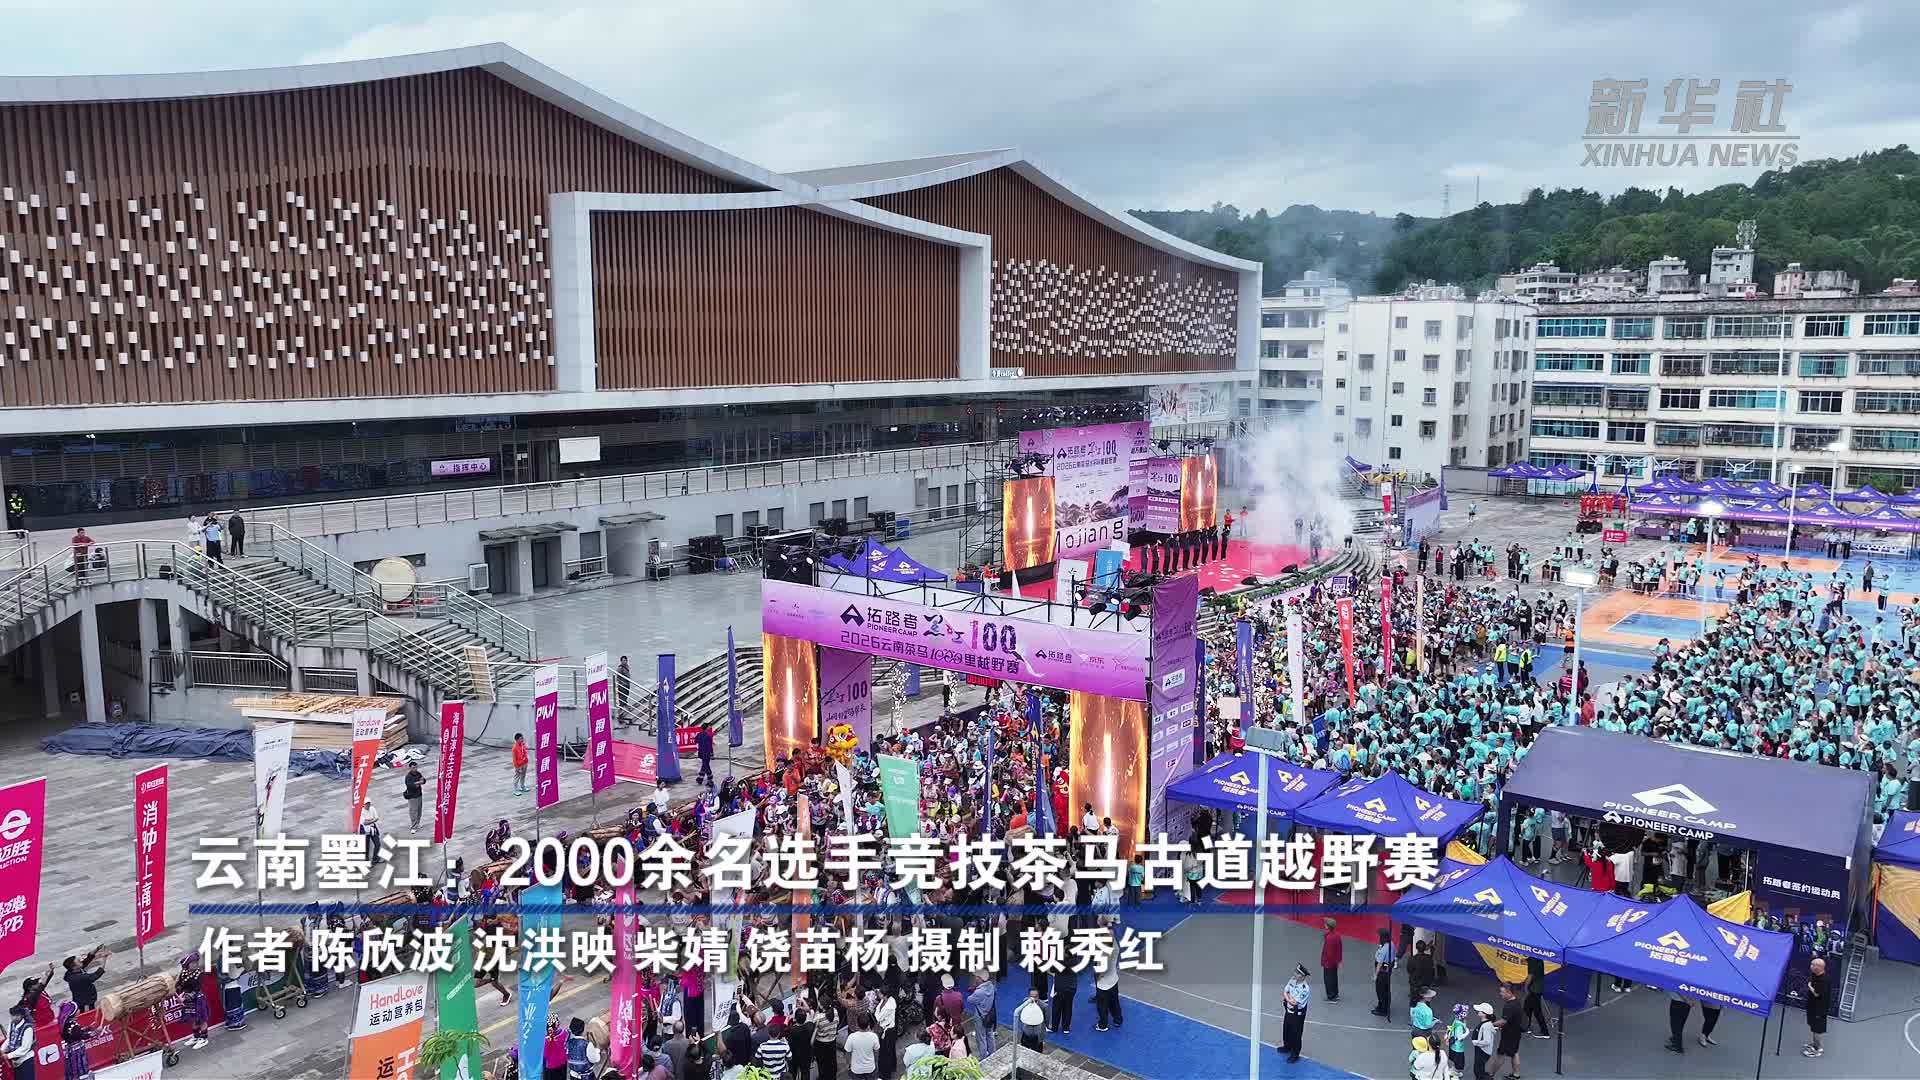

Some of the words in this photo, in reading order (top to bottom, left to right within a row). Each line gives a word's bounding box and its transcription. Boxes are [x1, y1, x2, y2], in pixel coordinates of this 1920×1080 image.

[453, 462, 488, 472] 指挥中心
[867, 606, 917, 630] 拓路者
[1603, 801, 1682, 821] PIONEER
[1683, 815, 1737, 829] CAMP
[1623, 815, 1677, 835] PIONEER
[1678, 826, 1714, 840] CAMP
[1763, 876, 1840, 899] 拓路者签约运动员
[1497, 938, 1532, 952] PIONEER
[1532, 948, 1556, 958] CAMP
[1634, 941, 1678, 955] PIONEER
[1678, 951, 1709, 962] CAMP
[370, 984, 424, 1010] HandLove
[1690, 986, 1731, 1002] PIONEER
[1731, 997, 1760, 1009] CAMP
[369, 998, 423, 1026] 运动营养包
